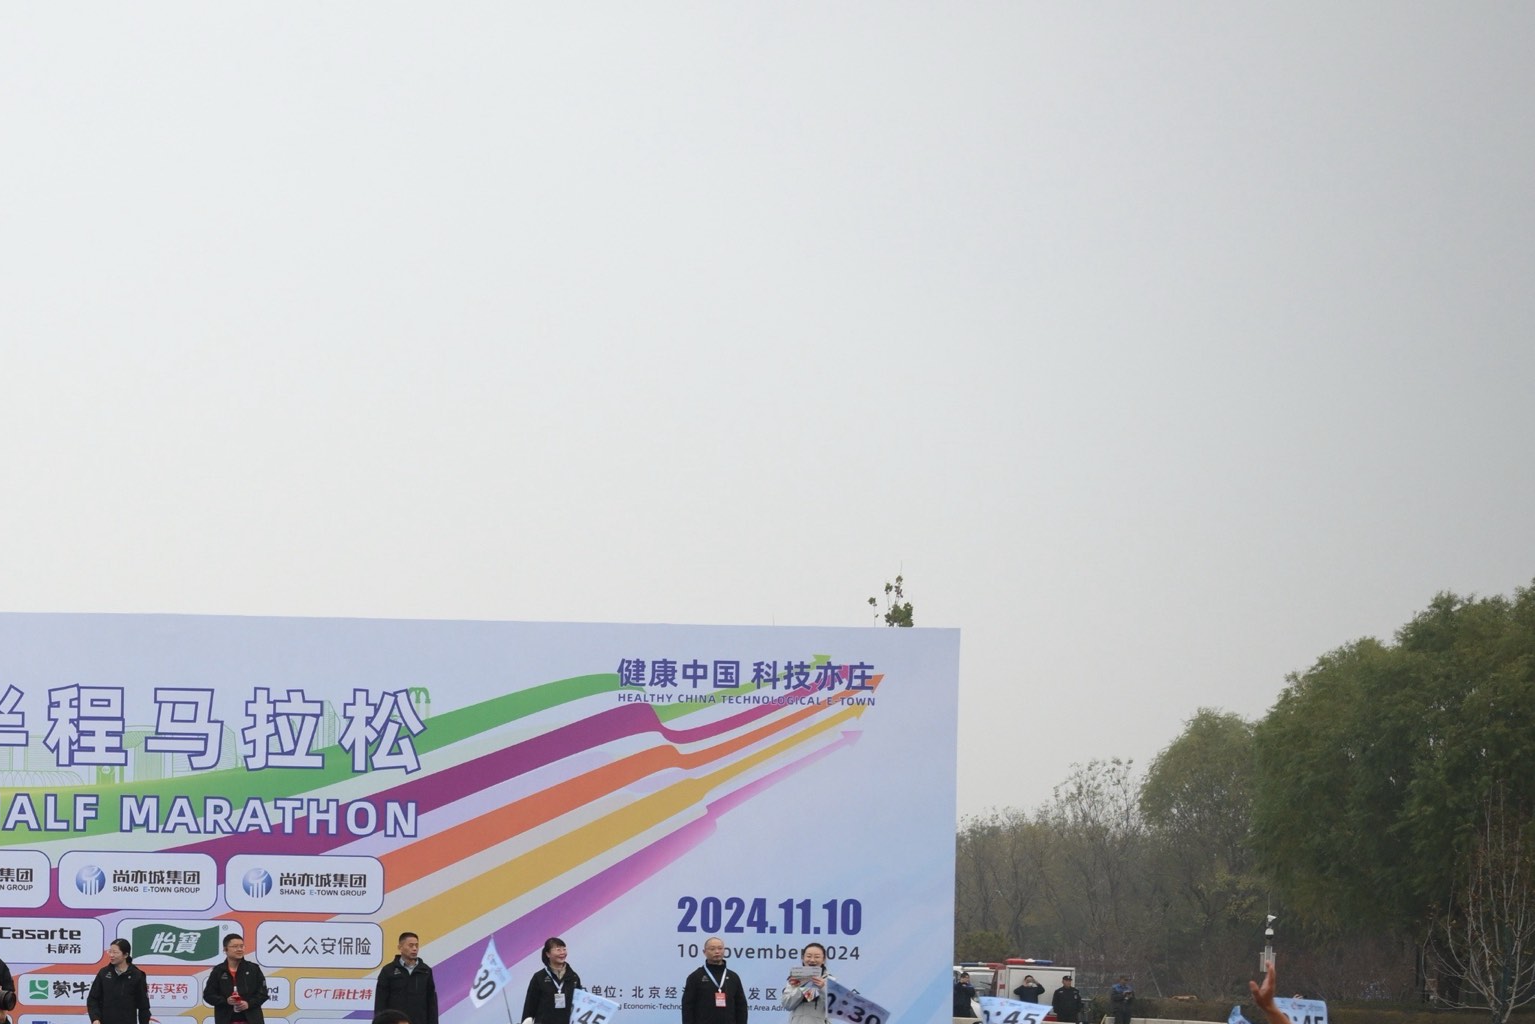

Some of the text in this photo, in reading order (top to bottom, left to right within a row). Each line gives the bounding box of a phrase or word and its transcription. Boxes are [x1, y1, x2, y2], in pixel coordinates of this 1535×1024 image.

[617, 658, 875, 691] 健康中国 科技亦庄
[617, 693, 673, 703] HEALTHY
[677, 694, 716, 704] CHINA
[721, 695, 822, 706] TECHNOLOGICAL
[119, 795, 419, 838] MARATHON
[112, 869, 201, 885] 尚亦城集团
[279, 872, 367, 888] 尚亦城集团
[7, 884, 33, 892] GROUP
[112, 885, 139, 893] SHANG
[174, 886, 201, 894] GROUP
[279, 888, 306, 896] SHANG
[340, 889, 367, 897] GROUP
[677, 896, 862, 936] 2024.11.10
[45, 943, 82, 955] 卡萨帝
[301, 937, 372, 956] 众安保险
[677, 944, 698, 958] 10
[826, 946, 860, 960] 024
[53, 980, 90, 1000] 蒙牛
